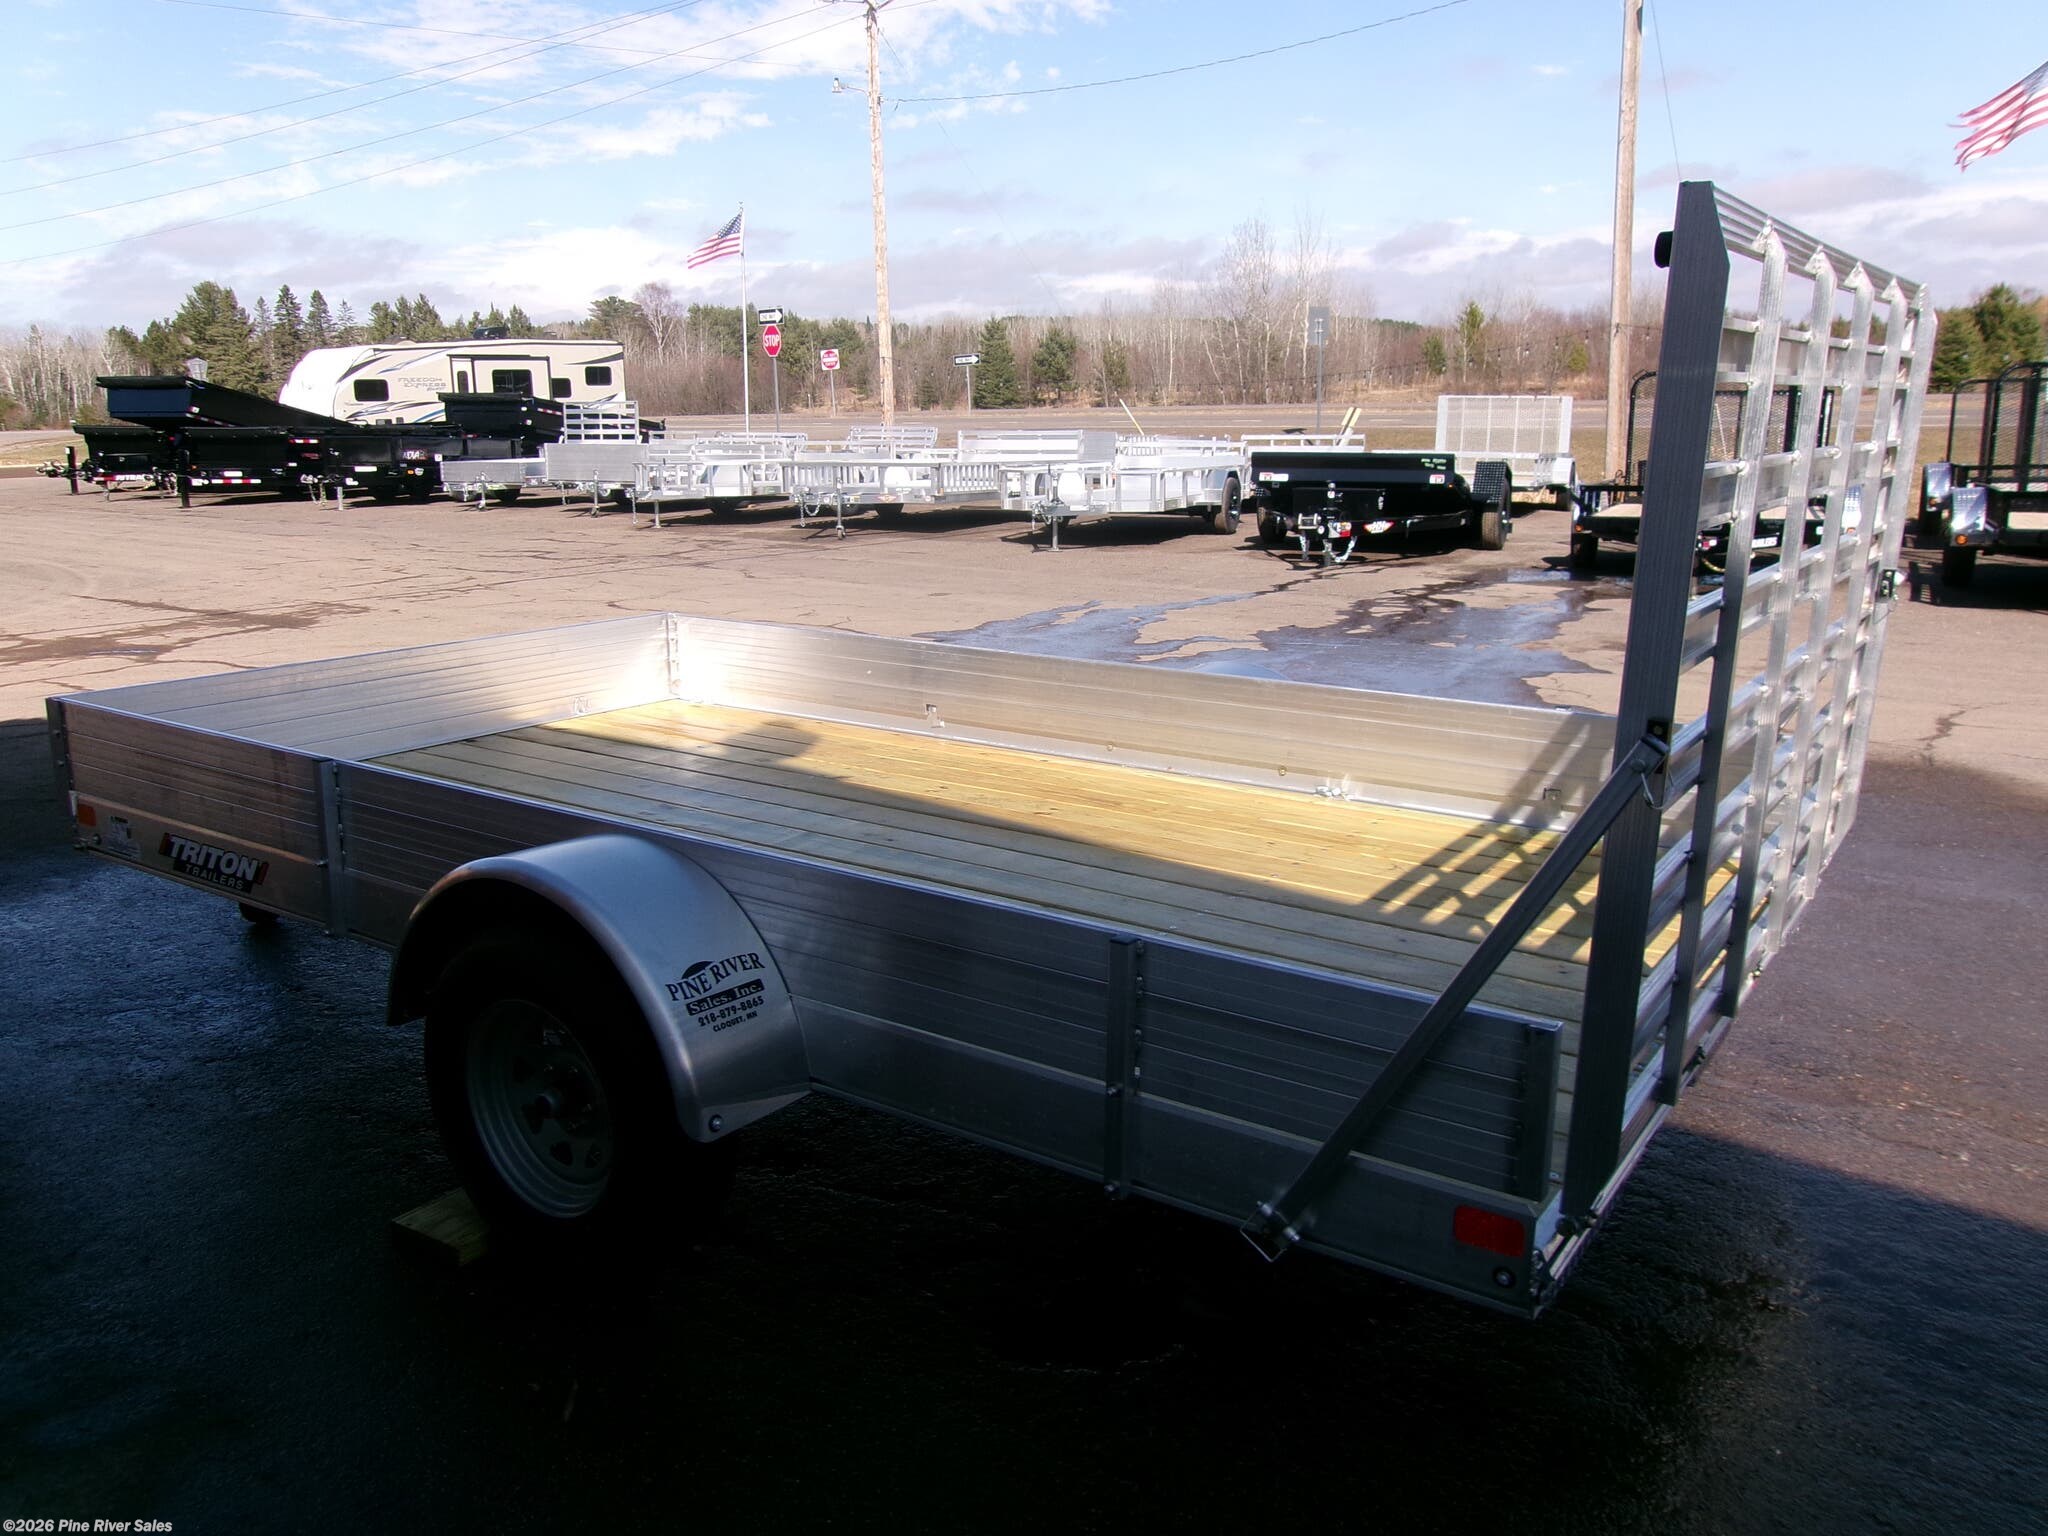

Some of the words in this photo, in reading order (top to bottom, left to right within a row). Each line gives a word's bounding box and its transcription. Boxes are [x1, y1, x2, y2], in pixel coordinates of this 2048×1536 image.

[764, 334, 780, 347] STOP
[170, 835, 258, 881] TRITON
[185, 864, 244, 890] TRAILERS
[665, 971, 713, 1001] PINE
[709, 952, 766, 985] RIVER
[733, 984, 762, 998] Inc.
[698, 995, 764, 1027] 218-879-8865
[746, 1010, 758, 1020] MN
